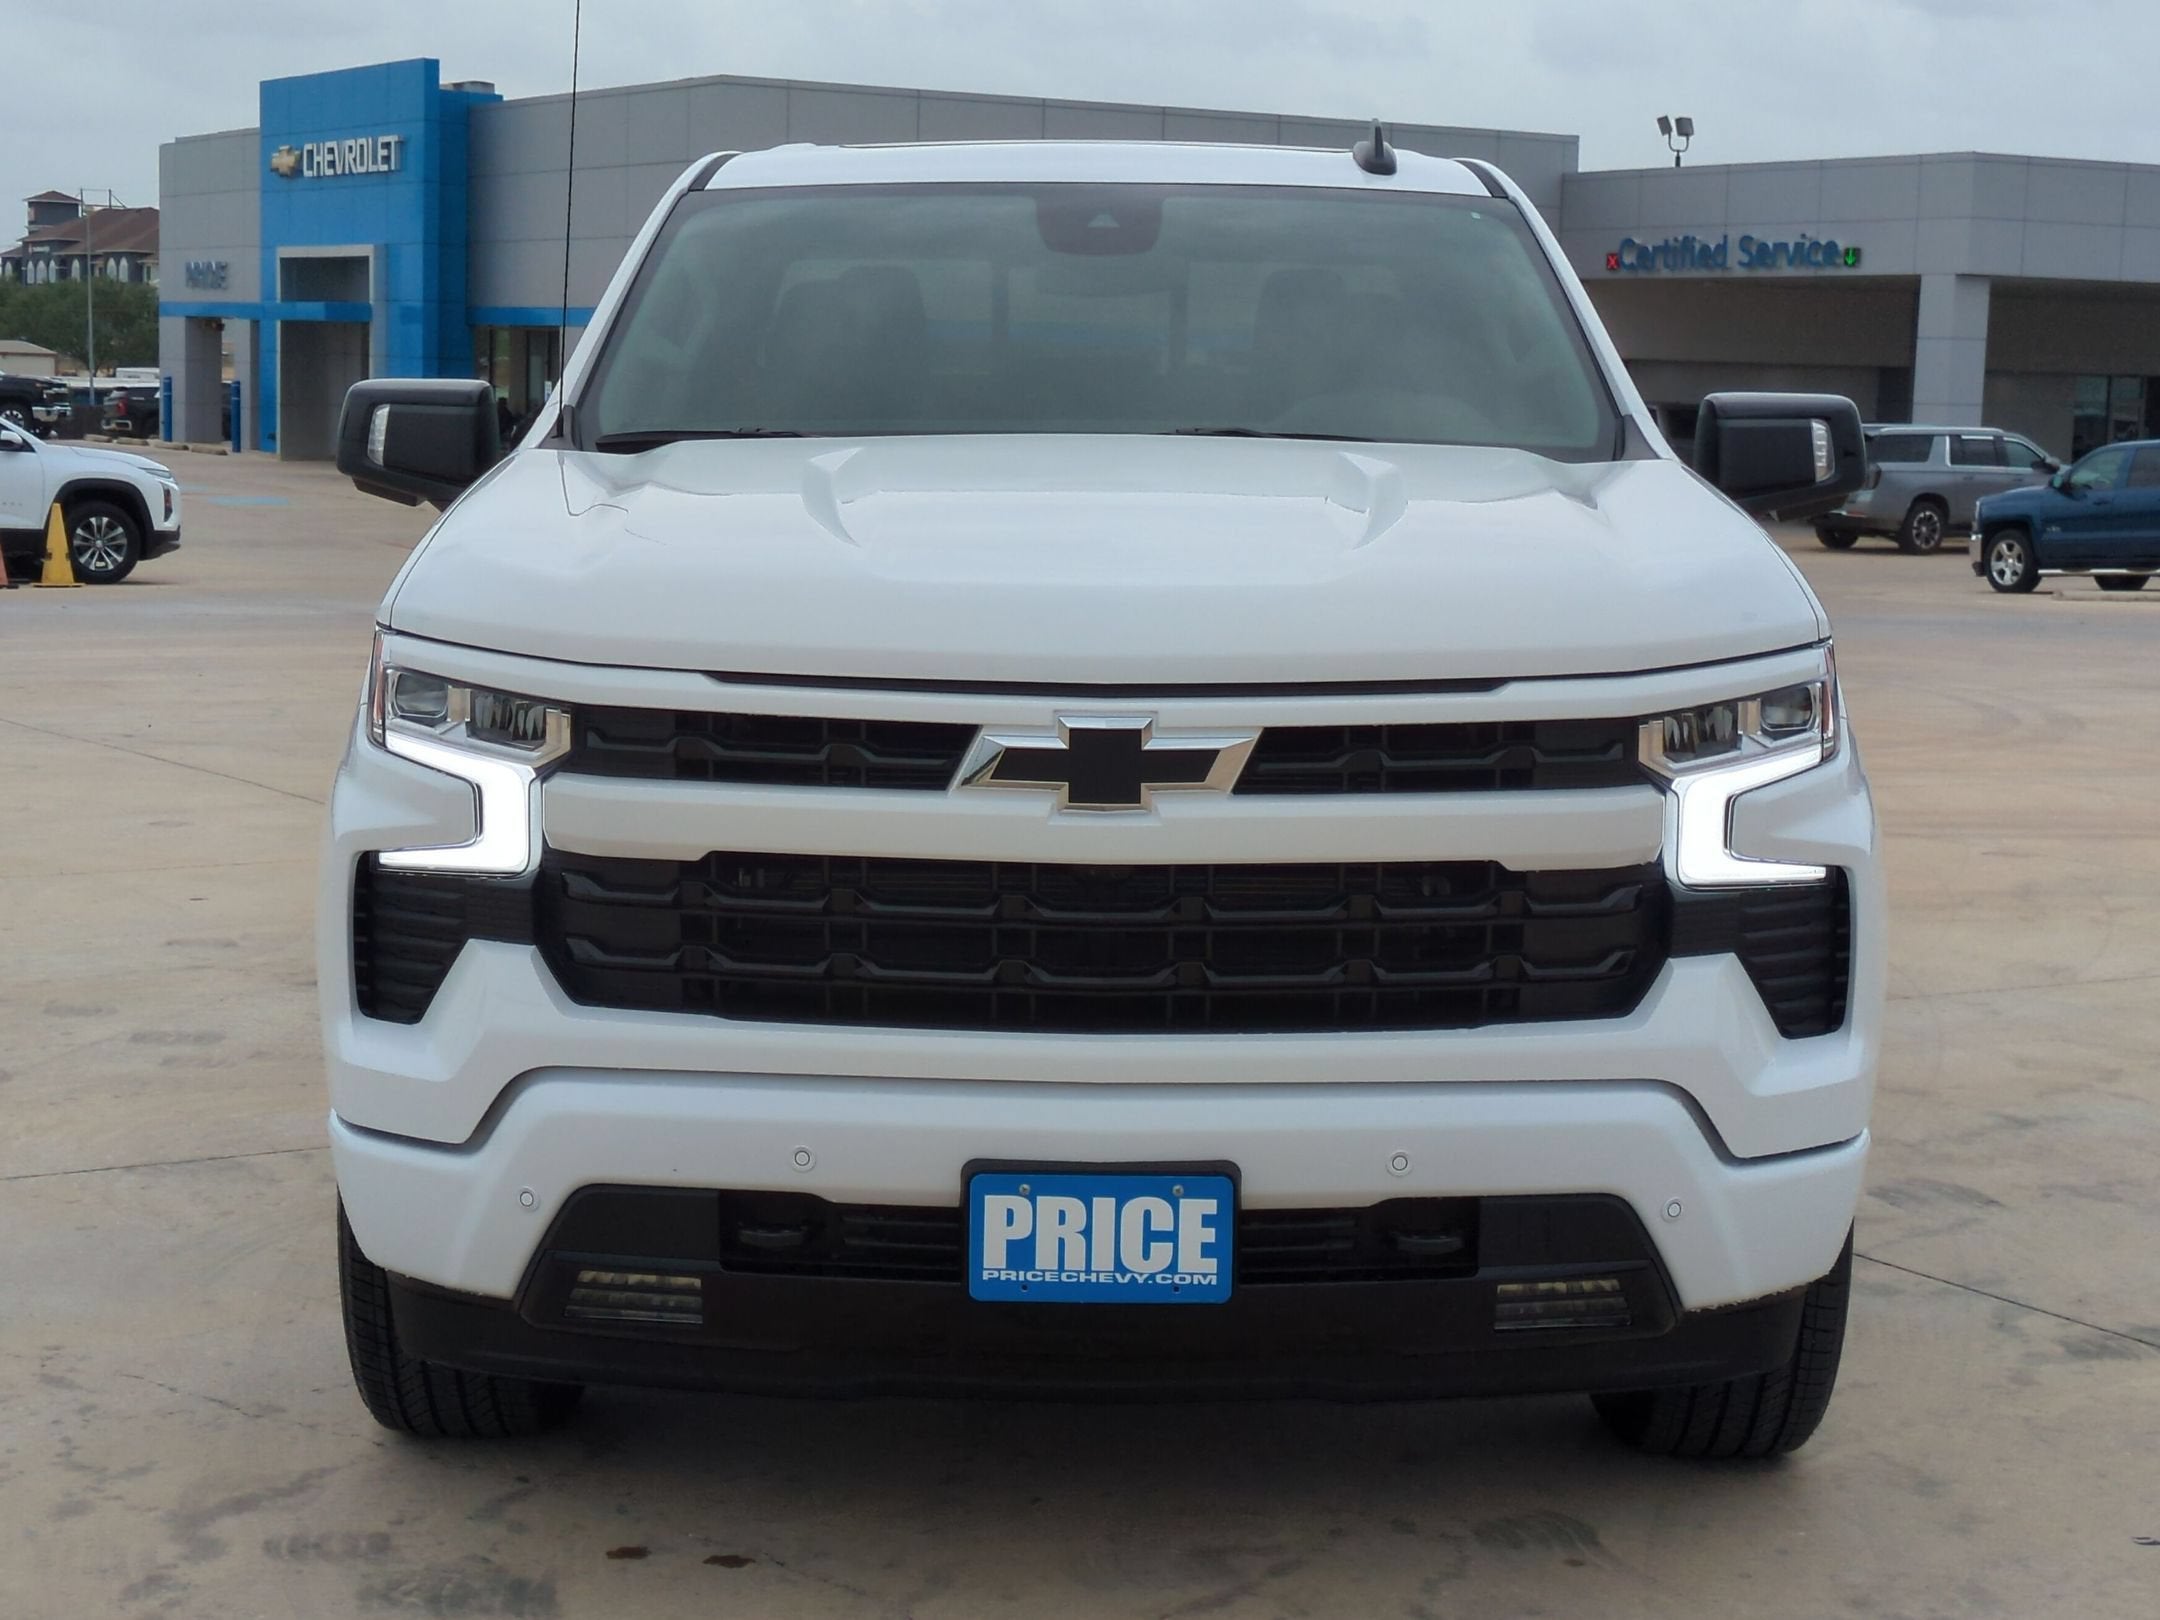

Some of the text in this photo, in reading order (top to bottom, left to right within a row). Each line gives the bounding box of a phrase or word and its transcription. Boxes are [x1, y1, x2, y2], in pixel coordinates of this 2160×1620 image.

[303, 135, 399, 177] CHEVROLET
[1619, 233, 1841, 271] Certified Service
[983, 1194, 1218, 1274] PRICE
[982, 1269, 1218, 1286] PRICECHEVY.COM
